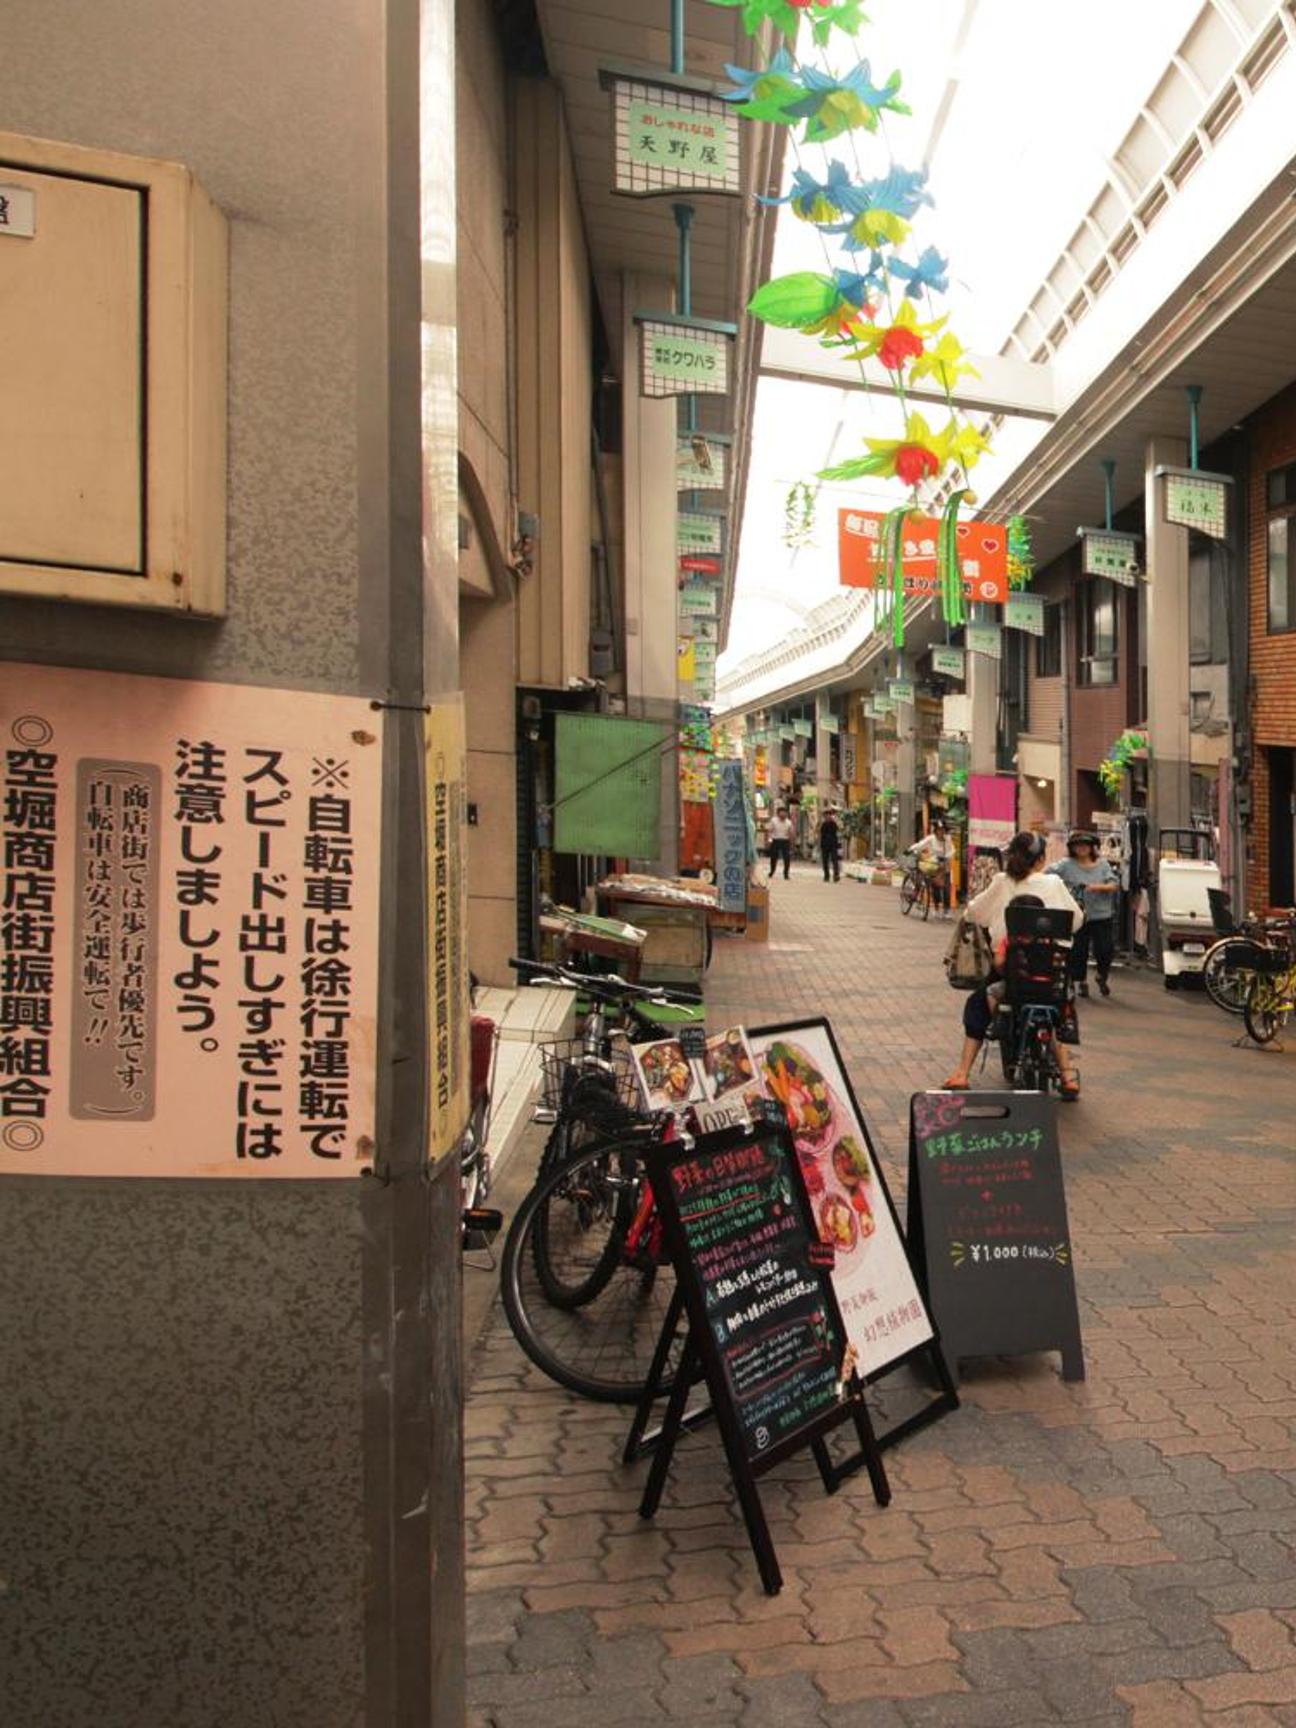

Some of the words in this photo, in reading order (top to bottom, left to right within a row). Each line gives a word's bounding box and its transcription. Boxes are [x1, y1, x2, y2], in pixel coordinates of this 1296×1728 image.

[639, 135, 718, 165] 天野屋
[116, 783, 149, 1100] 商店街では歩行者優先です。
[720, 763, 744, 901] パナソニックの店
[237, 747, 293, 1160] スピード出しすぎには
